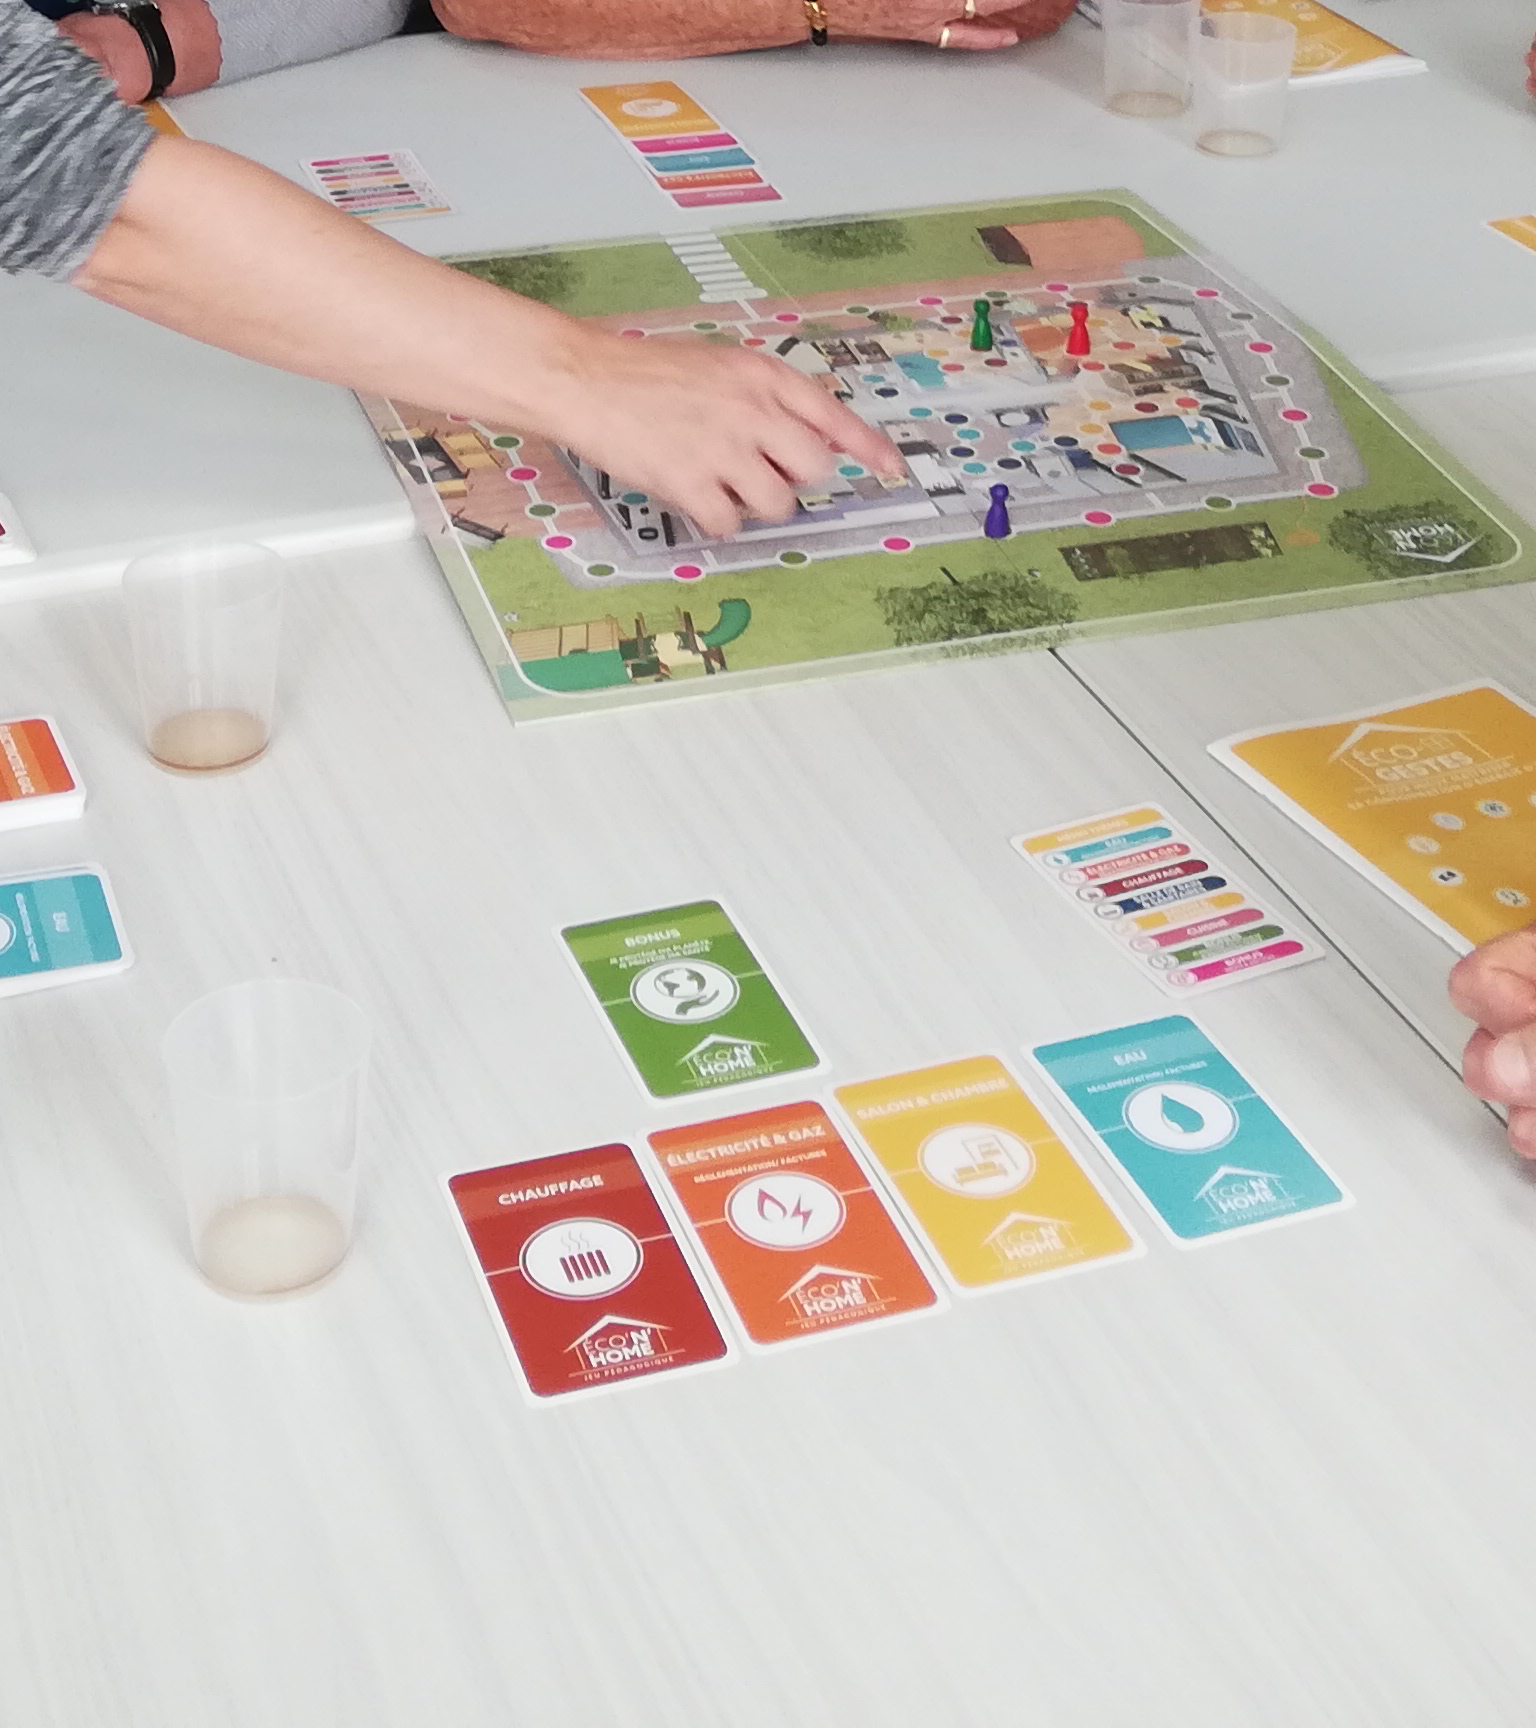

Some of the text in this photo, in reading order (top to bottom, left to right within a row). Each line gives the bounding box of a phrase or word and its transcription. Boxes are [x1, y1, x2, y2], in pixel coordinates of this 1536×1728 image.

[1375, 751, 1474, 782] GESTES
[624, 928, 681, 948] BONUS
[698, 1053, 757, 1077] HOME
[1113, 1049, 1148, 1067] EAU
[856, 1077, 1010, 1121] SALON & CHAMBRE
[667, 1125, 826, 1168] ÉLECTRICITÉ & GAZ
[498, 1174, 604, 1206] CHAUFFAGE
[1218, 1187, 1277, 1214] HOME
[1004, 1238, 1065, 1260] HOME
[803, 1292, 867, 1317] HOME
[588, 1341, 655, 1369] HOME
